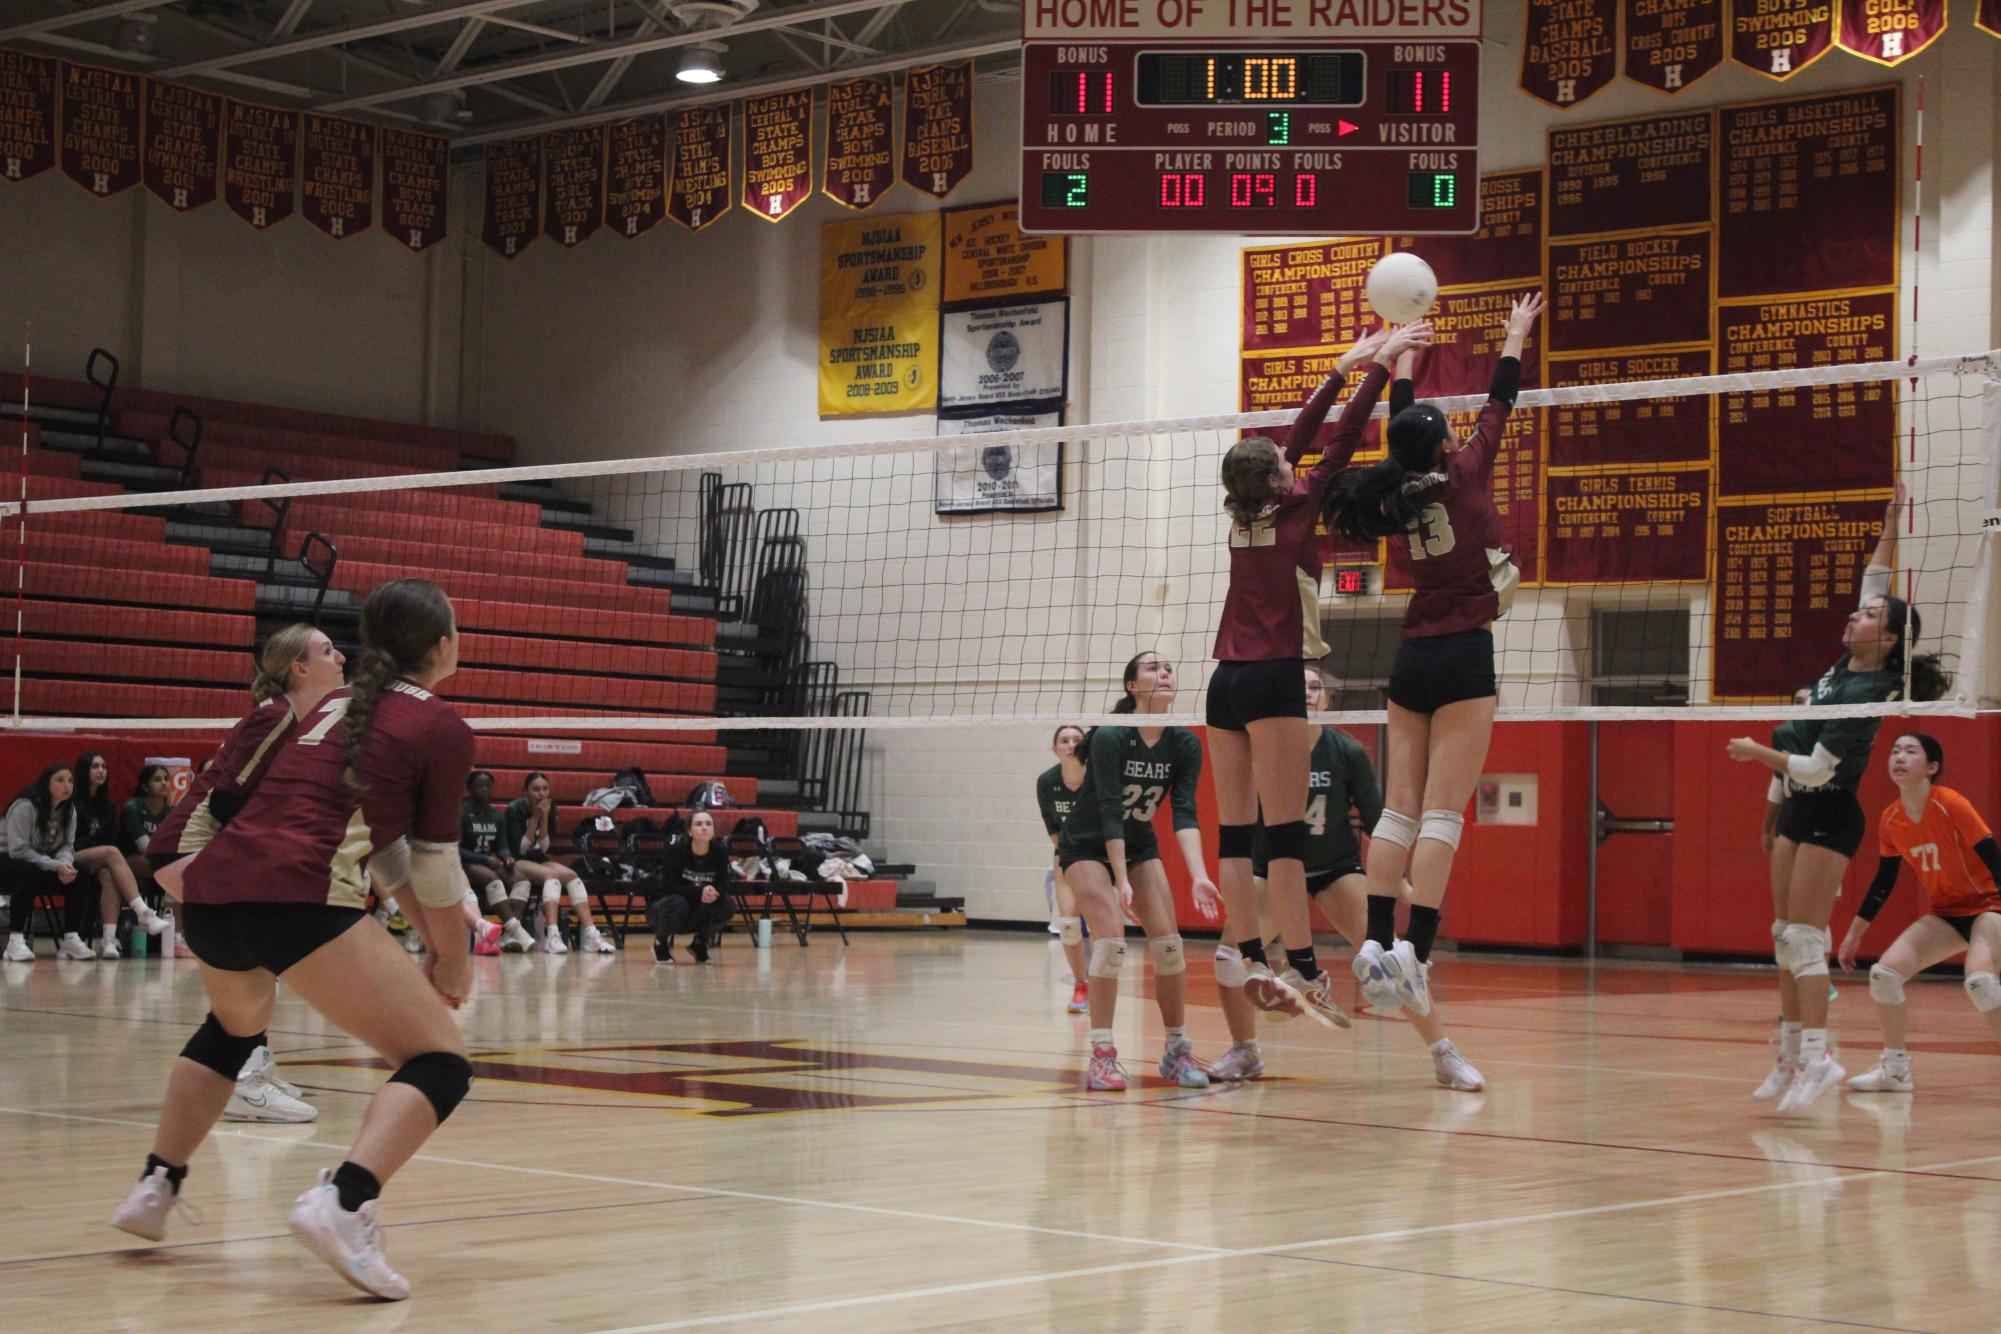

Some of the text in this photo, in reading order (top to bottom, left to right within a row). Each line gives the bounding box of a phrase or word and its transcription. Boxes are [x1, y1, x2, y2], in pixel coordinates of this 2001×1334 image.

[1036, 0, 1471, 28] HOME OF THE RAIDERS
[1548, 0, 1594, 22] STATE
[1736, 5, 1829, 33] SWIMMING
[1540, 16, 1604, 45] CHAMPS
[1671, 23, 1716, 45] COUNTRY
[1867, 13, 1920, 34] 2006
[1756, 28, 1808, 49] 2006
[1882, 31, 1904, 58] H
[1057, 47, 1109, 63] BONUS
[1394, 46, 1446, 62] BONUS
[1529, 36, 1612, 63] BASEBALL
[1649, 44, 1697, 65] 2005
[1770, 47, 1791, 73] H
[1207, 57, 1296, 99] 1:00
[1548, 58, 1593, 81] 2005
[1664, 64, 1682, 89] H
[1079, 72, 1113, 113] 11
[1415, 71, 1450, 113] 11
[1556, 79, 1577, 102] H
[80, 103, 121, 125] STATE
[748, 93, 808, 115] NJSIAA
[1735, 95, 1880, 129] GIRLS BASKETBALL
[751, 110, 794, 128] CENTRAL
[1167, 124, 1190, 134] POSS
[1207, 122, 1256, 137] PERIOD
[1267, 112, 1290, 145] 3
[1308, 123, 1331, 134] POSS
[1728, 113, 1888, 145] CHAMPIONSHIPS
[73, 118, 128, 143] CHAMPS
[162, 118, 203, 142] STATE
[757, 122, 799, 142] STATE
[1047, 123, 1117, 143] HOME
[1379, 123, 1456, 143] VISITOR
[1554, 116, 1706, 149] CHEERLEADING
[1828, 132, 1872, 149] COUNTY
[65, 133, 136, 161] GYMNASTICS
[154, 134, 208, 161] CHAMPS
[243, 139, 281, 160] STATE
[751, 134, 804, 156] CHAMPS
[1551, 133, 1710, 165] CHAMPIONSHIPS
[1731, 140, 1798, 159] CONFERENCE
[80, 154, 120, 175] 2000
[234, 154, 289, 178] CHAMPS
[320, 151, 360, 173] STATE
[394, 158, 438, 179] STATE
[761, 150, 795, 169] BOYS
[1042, 153, 1090, 170] FOULS
[1154, 154, 1213, 170] PLAYER
[1226, 153, 1281, 170] POINTS
[1295, 153, 1343, 170] FOULS
[1409, 153, 1458, 170] FOULS
[1567, 162, 1611, 177] DIVISION
[1637, 152, 1702, 170] CONFERENCE
[227, 167, 295, 194] WRESTLING
[314, 166, 364, 189] CHAMPS
[748, 160, 808, 184] SWIMMING
[303, 180, 371, 205] WRESTLING
[760, 178, 795, 196] 2005
[1066, 174, 1088, 206] 2
[1161, 174, 1204, 206] 00
[1231, 174, 1275, 207] 09
[1296, 174, 1317, 206] 0
[1434, 174, 1456, 206] 0
[242, 188, 275, 209] 2001
[319, 199, 356, 219] 2002
[768, 193, 783, 216] H
[862, 229, 902, 247] NJSIAA
[837, 246, 926, 269] SPORTSMANSHIP
[1250, 242, 1380, 268] GIRLS CROSS COUNTRY
[1579, 238, 1680, 262] FIELD HOCKEY
[863, 266, 899, 284] AWARD
[1253, 258, 1378, 284] CHAMPIONSHIPS
[1556, 254, 1702, 280] CHAMPIONSHIPS
[1255, 282, 1308, 296] CONFERENCE
[1330, 275, 1364, 289] COUNTY
[1558, 278, 1621, 294] CONFERENCE
[1648, 272, 1686, 286] COUNTY
[1760, 300, 1851, 322] GYMNASTICS
[853, 326, 896, 344] NJSIAA
[966, 317, 1042, 333] Sportsmanship Award
[1727, 314, 1886, 341] CHAMPIONSHIPS
[1729, 338, 1797, 355] CONFERENCE
[1826, 333, 1869, 348] COUNTY
[830, 343, 921, 364] SPORTSMANSHIP
[854, 363, 894, 380] AWARD
[978, 371, 1025, 384] 2006-2007
[1263, 360, 1296, 375] GIRLS
[1579, 357, 1680, 379] GIRLS SOCCER
[846, 381, 899, 398] 2008-2009
[1251, 391, 1303, 403] CONFERENCE
[964, 419, 991, 429] Thomas
[1580, 475, 1677, 494] GIRLS TENNIS
[1555, 492, 1702, 512] CHAMPIONSHIPS
[1558, 512, 1619, 525] CONFERENCE
[1646, 510, 1686, 523] COUNTY
[1767, 505, 1841, 524] SOFTBALL
[1405, 501, 1456, 561] 13
[1725, 520, 1885, 542] CHAMPIONSHIPS
[1728, 541, 1794, 556] CONFERENCE
[1823, 538, 1866, 552] COUNTY
[1336, 570, 1362, 593] EXIT
[173, 770, 190, 791] G
[1123, 760, 1172, 780] BEARS
[1121, 783, 1165, 823] 23
[472, 822, 497, 834] BEARS
[1909, 841, 1942, 872] 77
